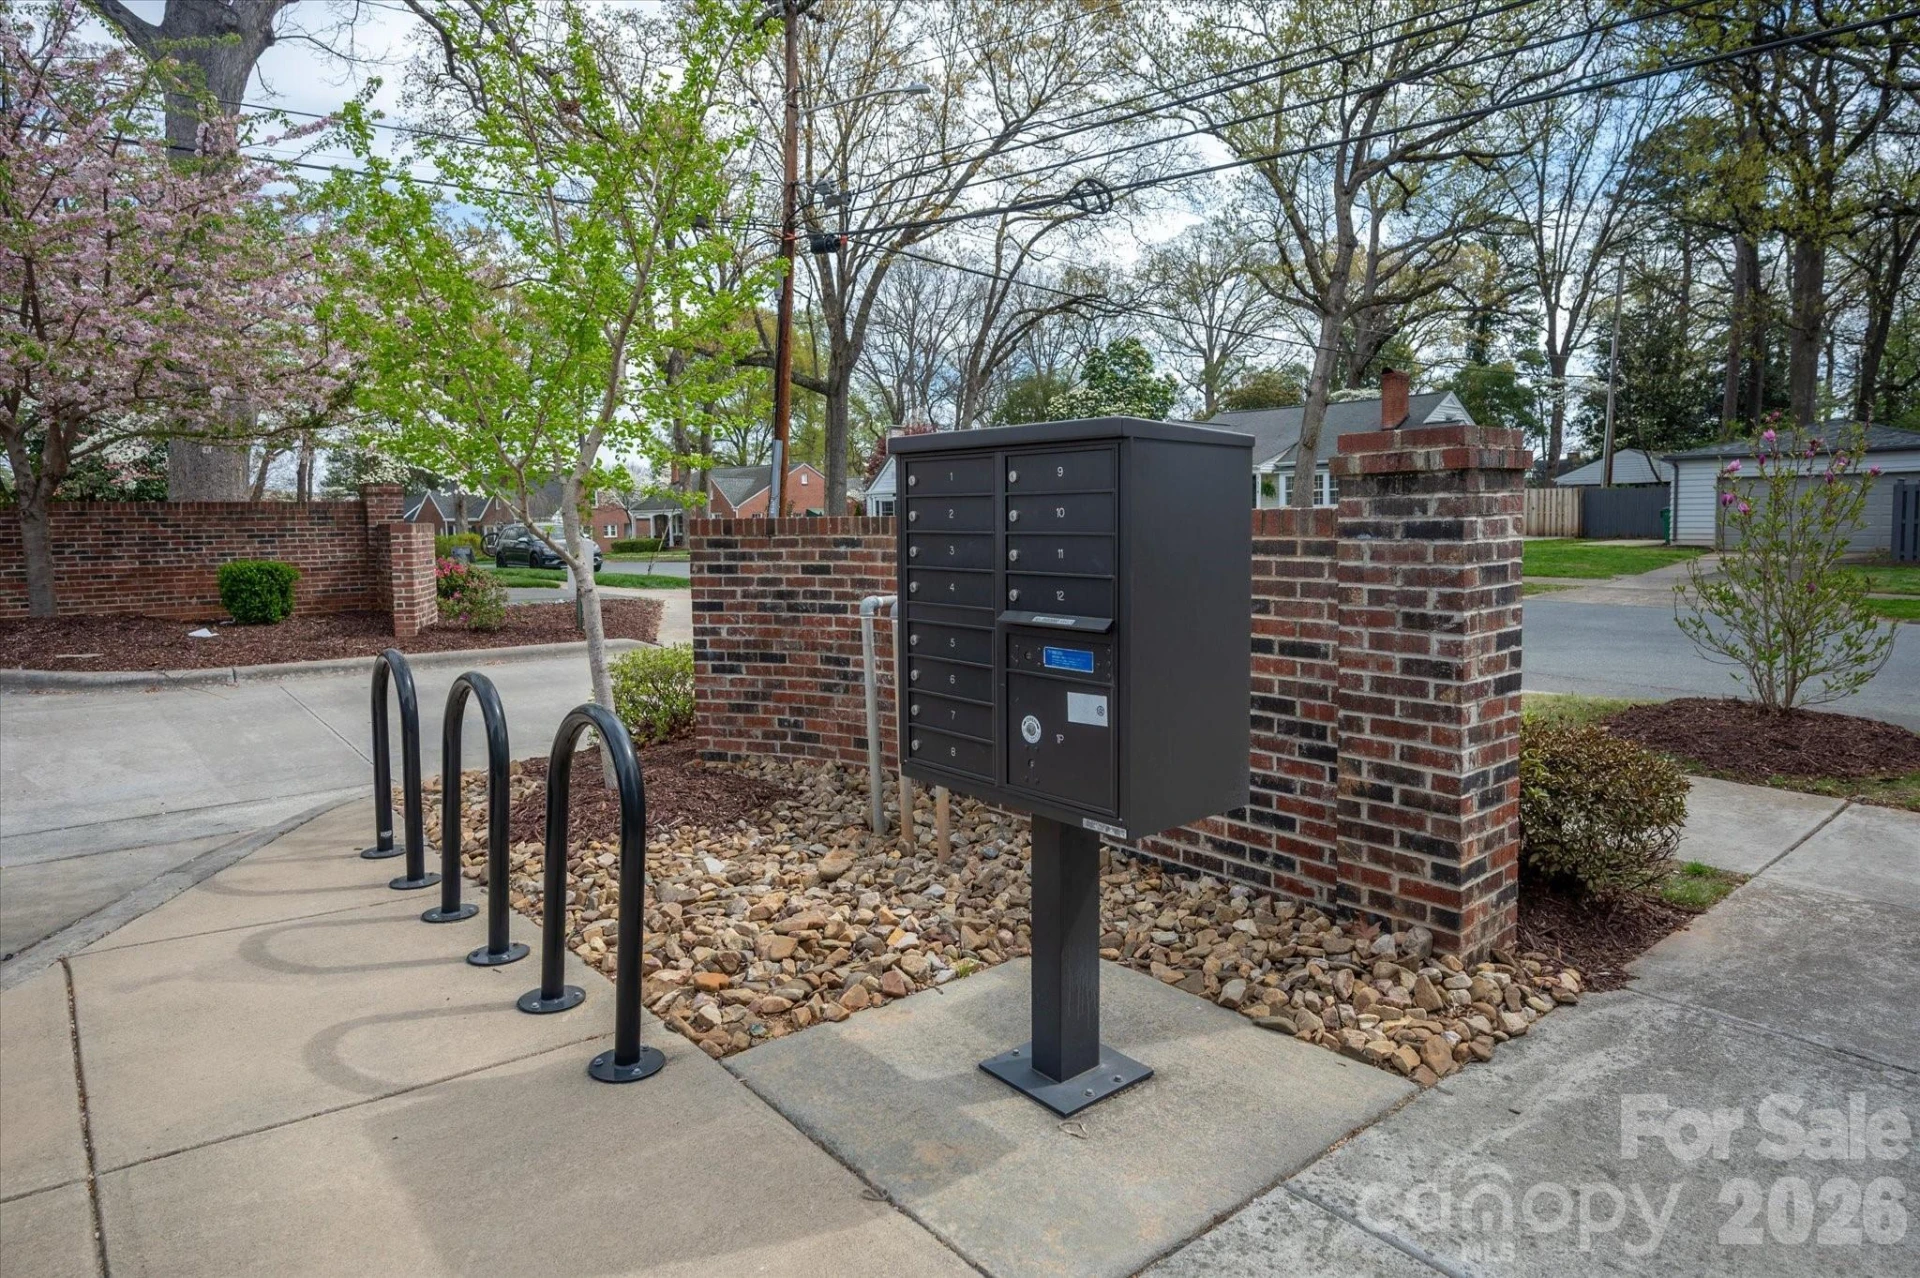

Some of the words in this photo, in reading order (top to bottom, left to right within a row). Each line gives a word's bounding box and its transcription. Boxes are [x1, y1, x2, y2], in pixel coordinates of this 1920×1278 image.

[1056, 466, 1064, 477] 9
[948, 509, 954, 519] 2
[1056, 507, 1065, 518] 10
[949, 546, 955, 555] 3
[1057, 549, 1064, 559] 11
[949, 583, 955, 591] 4
[1056, 590, 1065, 601] 12
[949, 638, 955, 647] 5
[949, 674, 956, 684] 6
[950, 710, 956, 720] 7
[950, 747, 956, 757] 8
